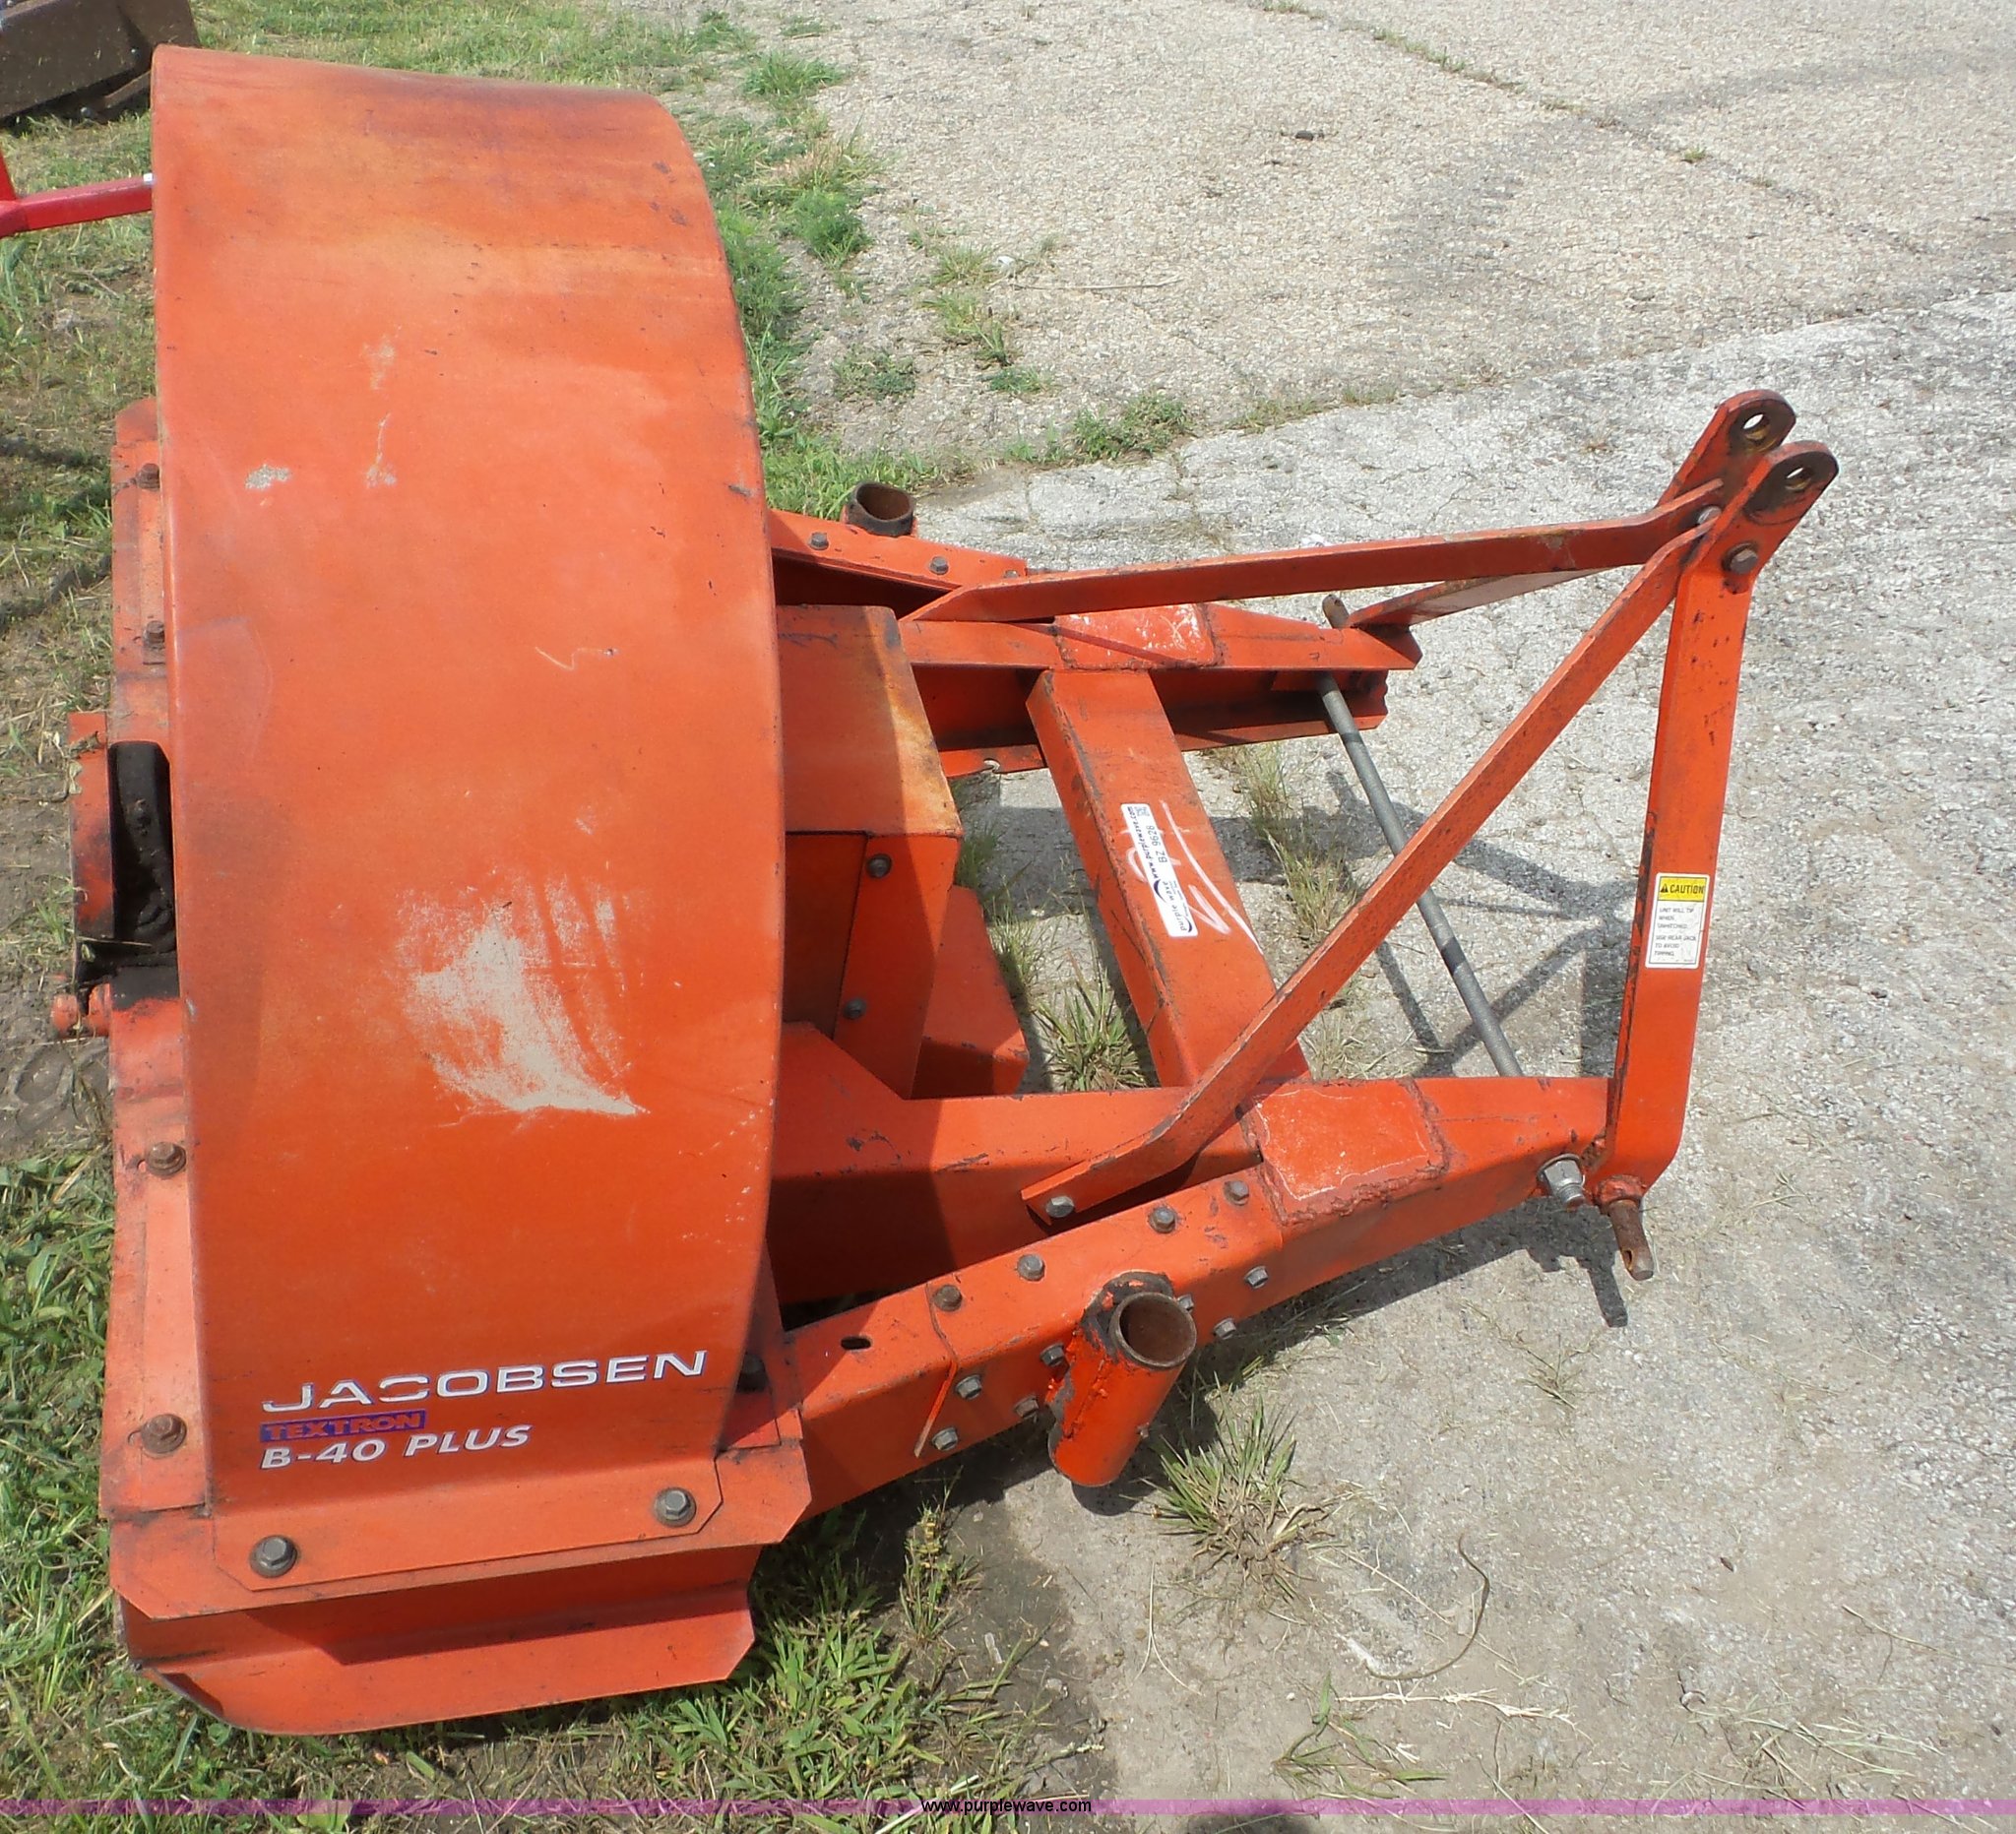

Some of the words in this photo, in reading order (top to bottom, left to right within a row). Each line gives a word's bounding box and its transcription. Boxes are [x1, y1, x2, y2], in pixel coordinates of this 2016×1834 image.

[1127, 806, 1159, 879] www.purplewave.com
[1146, 825, 1161, 847] 9628
[1156, 851, 1168, 863] BZ
[1163, 881, 1174, 901] wave
[1670, 884, 1704, 894] CAUTION
[1171, 905, 1188, 931] purple
[261, 1350, 708, 1413] JACOBSEN
[263, 1411, 425, 1440] TEXTRON
[260, 1438, 386, 1470] B-40
[404, 1424, 534, 1458] PLUS
